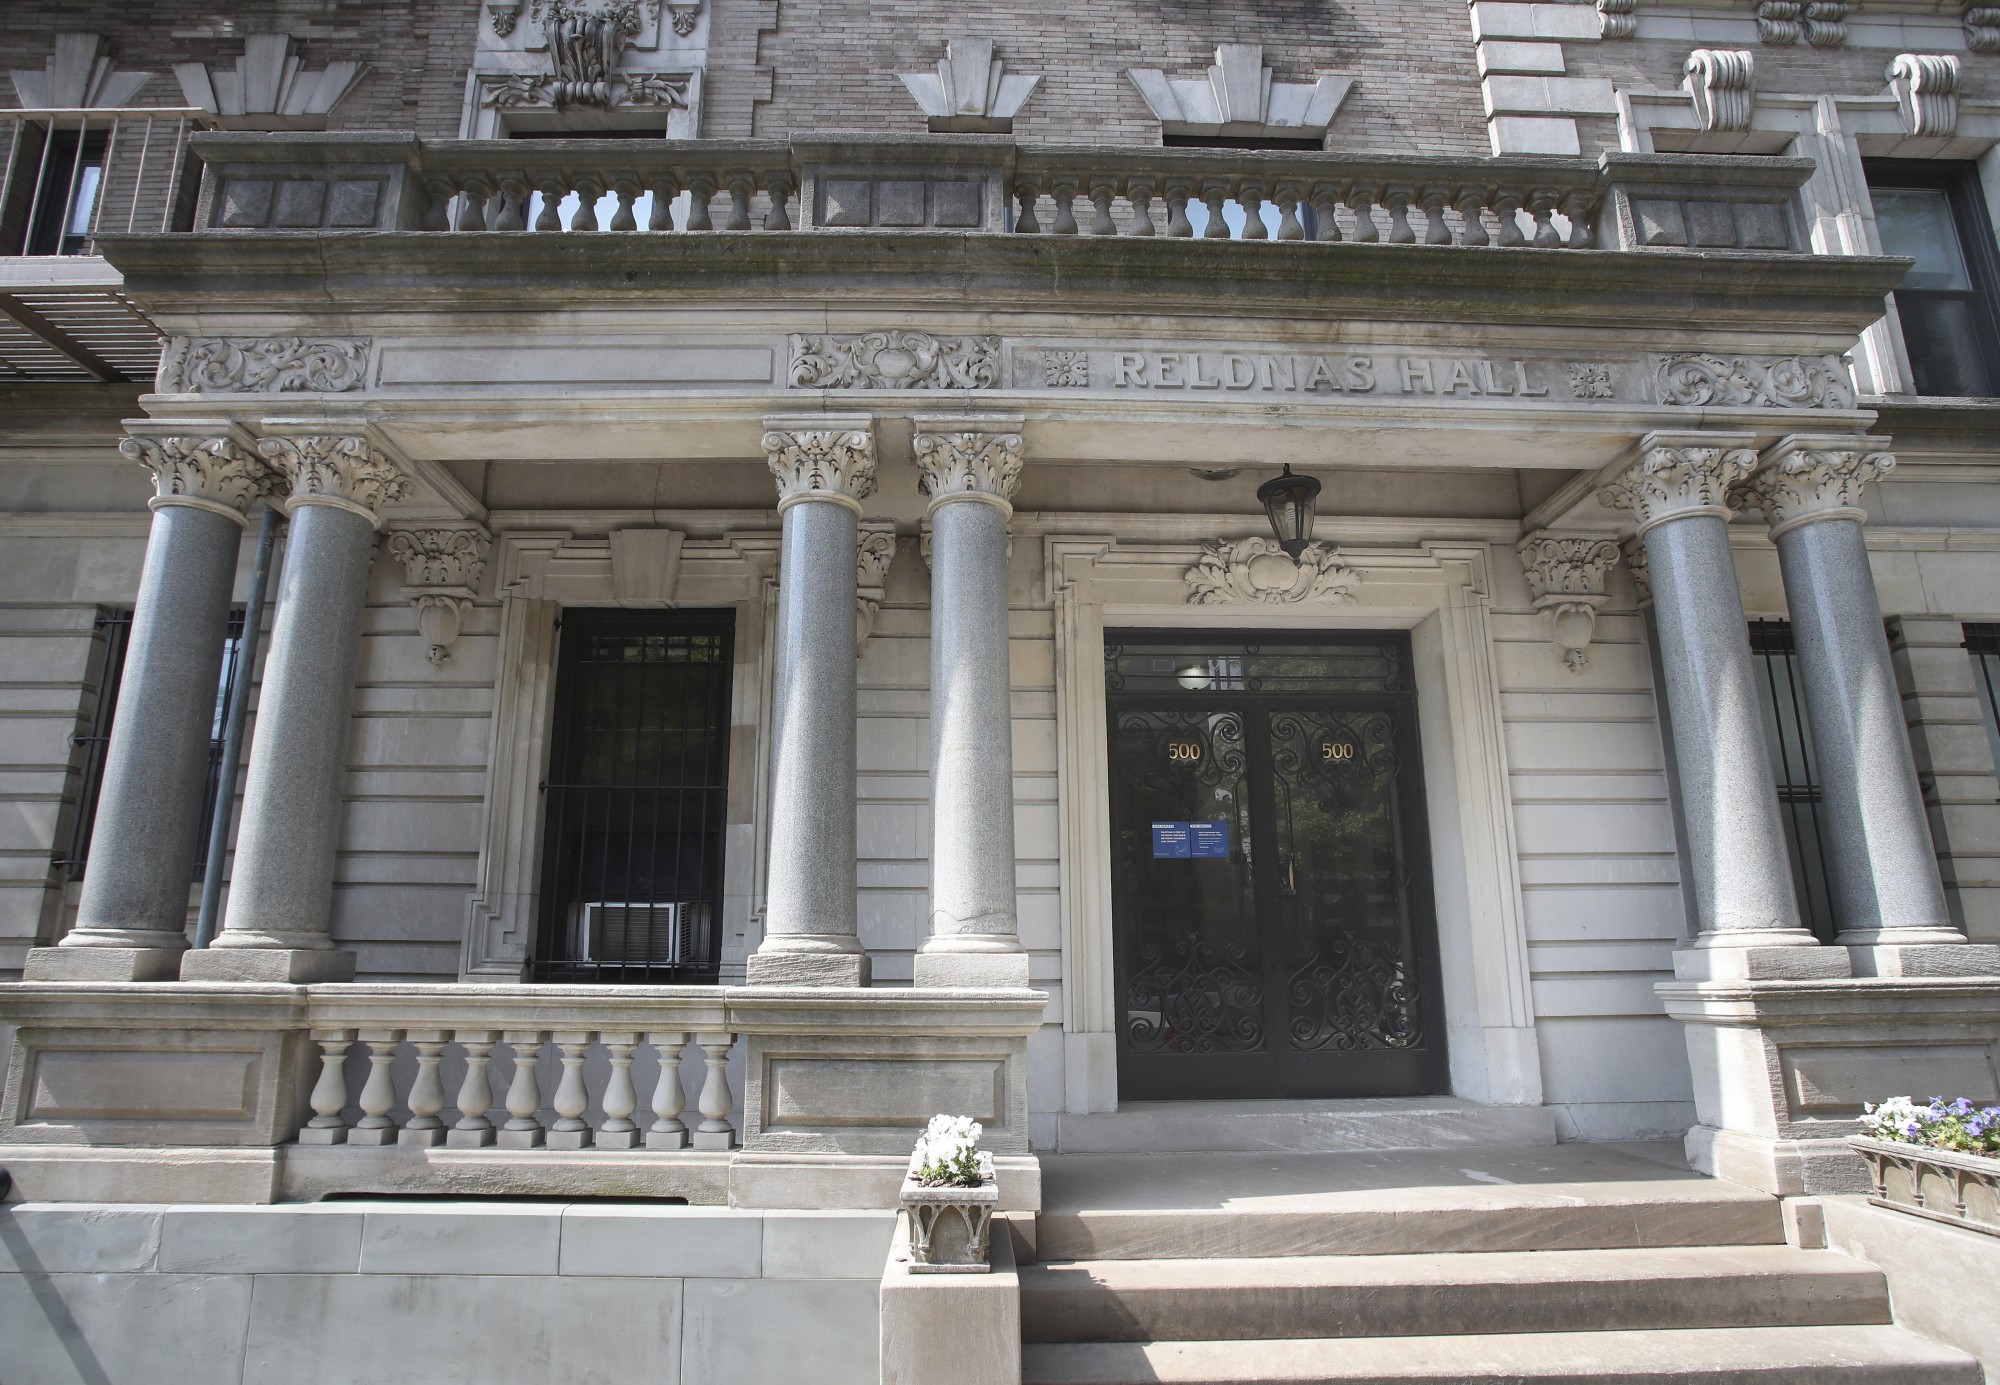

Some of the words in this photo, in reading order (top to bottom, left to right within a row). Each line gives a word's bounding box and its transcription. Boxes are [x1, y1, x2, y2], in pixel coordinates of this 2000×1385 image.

[1113, 352, 1376, 393] RELDNAS
[1400, 358, 1549, 397] HALL
[1169, 743, 1200, 759] 500
[1322, 743, 1354, 759] 500
